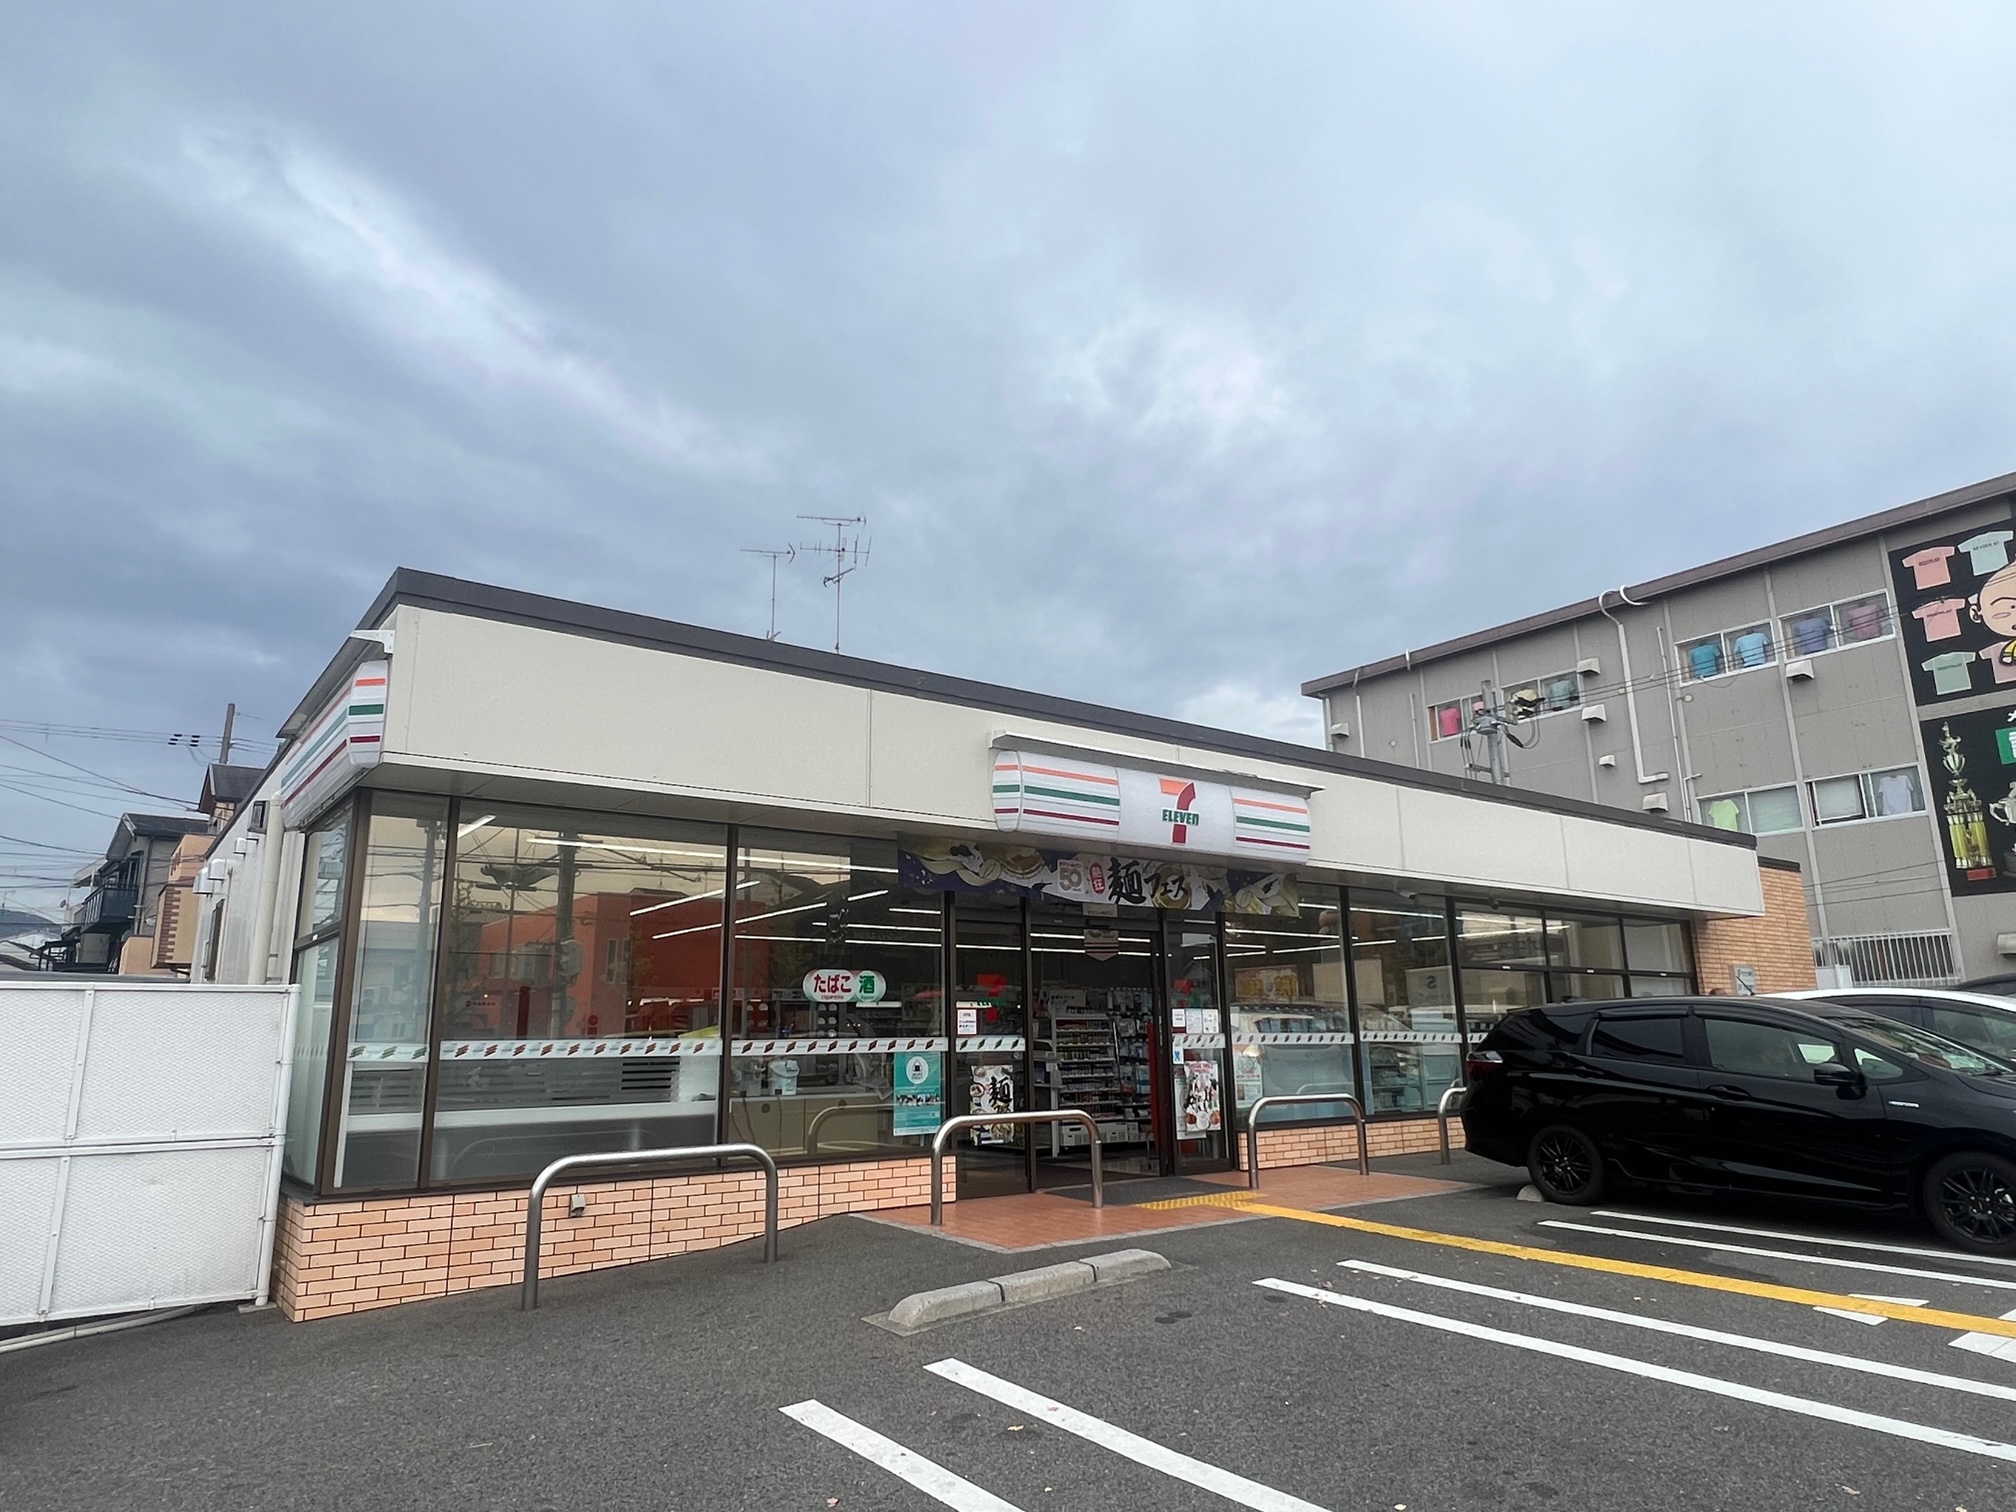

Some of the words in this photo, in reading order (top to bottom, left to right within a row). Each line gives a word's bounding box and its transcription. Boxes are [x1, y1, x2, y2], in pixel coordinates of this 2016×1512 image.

[813, 973, 851, 993] たばこ
[858, 974, 875, 993] 酒
